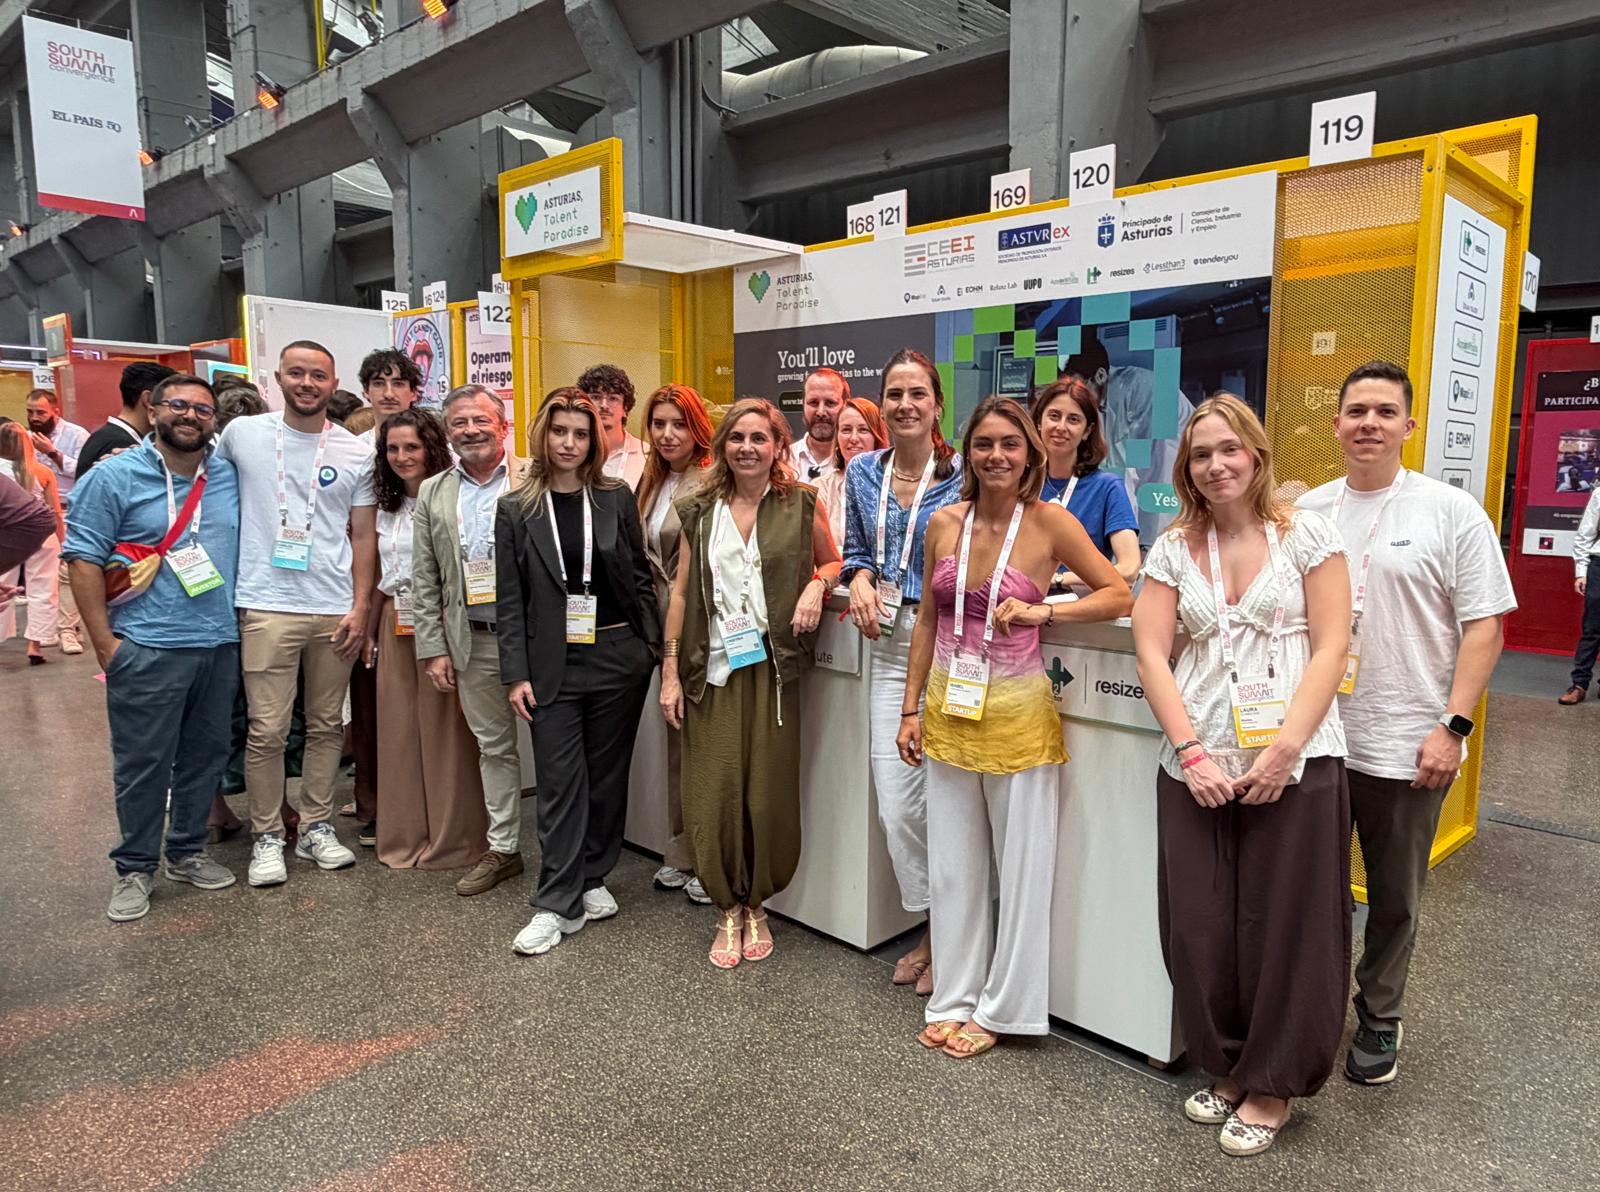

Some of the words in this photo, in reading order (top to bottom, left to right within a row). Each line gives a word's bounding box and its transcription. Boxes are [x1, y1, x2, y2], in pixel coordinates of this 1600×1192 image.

[48, 41, 105, 63] SOUTH
[49, 64, 115, 83] convergence
[52, 110, 71, 122] EL
[106, 121, 121, 133] 50
[1319, 114, 1364, 146] 119
[1073, 163, 1110, 189] 120
[543, 190, 583, 210] ASTURIAS,
[993, 185, 1026, 209] 169
[878, 205, 900, 227] 121
[1122, 216, 1162, 228] Principado
[1163, 214, 1173, 222] de
[849, 215, 875, 236] 168
[1121, 224, 1173, 242] Asturias
[927, 235, 975, 256] CEEI
[927, 253, 975, 268] ASTURIAS
[777, 272, 815, 285] ASTURIAS,
[1110, 268, 1135, 277] resizes
[433, 290, 445, 302] 124
[385, 299, 408, 312] 125
[483, 305, 512, 323] 122
[471, 351, 512, 369] Operam
[778, 347, 819, 369] You'll
[822, 346, 855, 366] love
[471, 371, 480, 383] el
[481, 368, 513, 387] riesgo
[777, 372, 804, 383] growing
[854, 369, 862, 377] to
[863, 367, 874, 377] the
[437, 380, 447, 394] 15
[1152, 492, 1178, 507] Yes
[816, 651, 833, 664] ute
[957, 661, 980, 670] SOUTH
[1095, 680, 1145, 699] resize
[1237, 682, 1268, 693] SOUTH
[948, 706, 977, 716] STARTUP
[1246, 734, 1279, 744] STARTU
